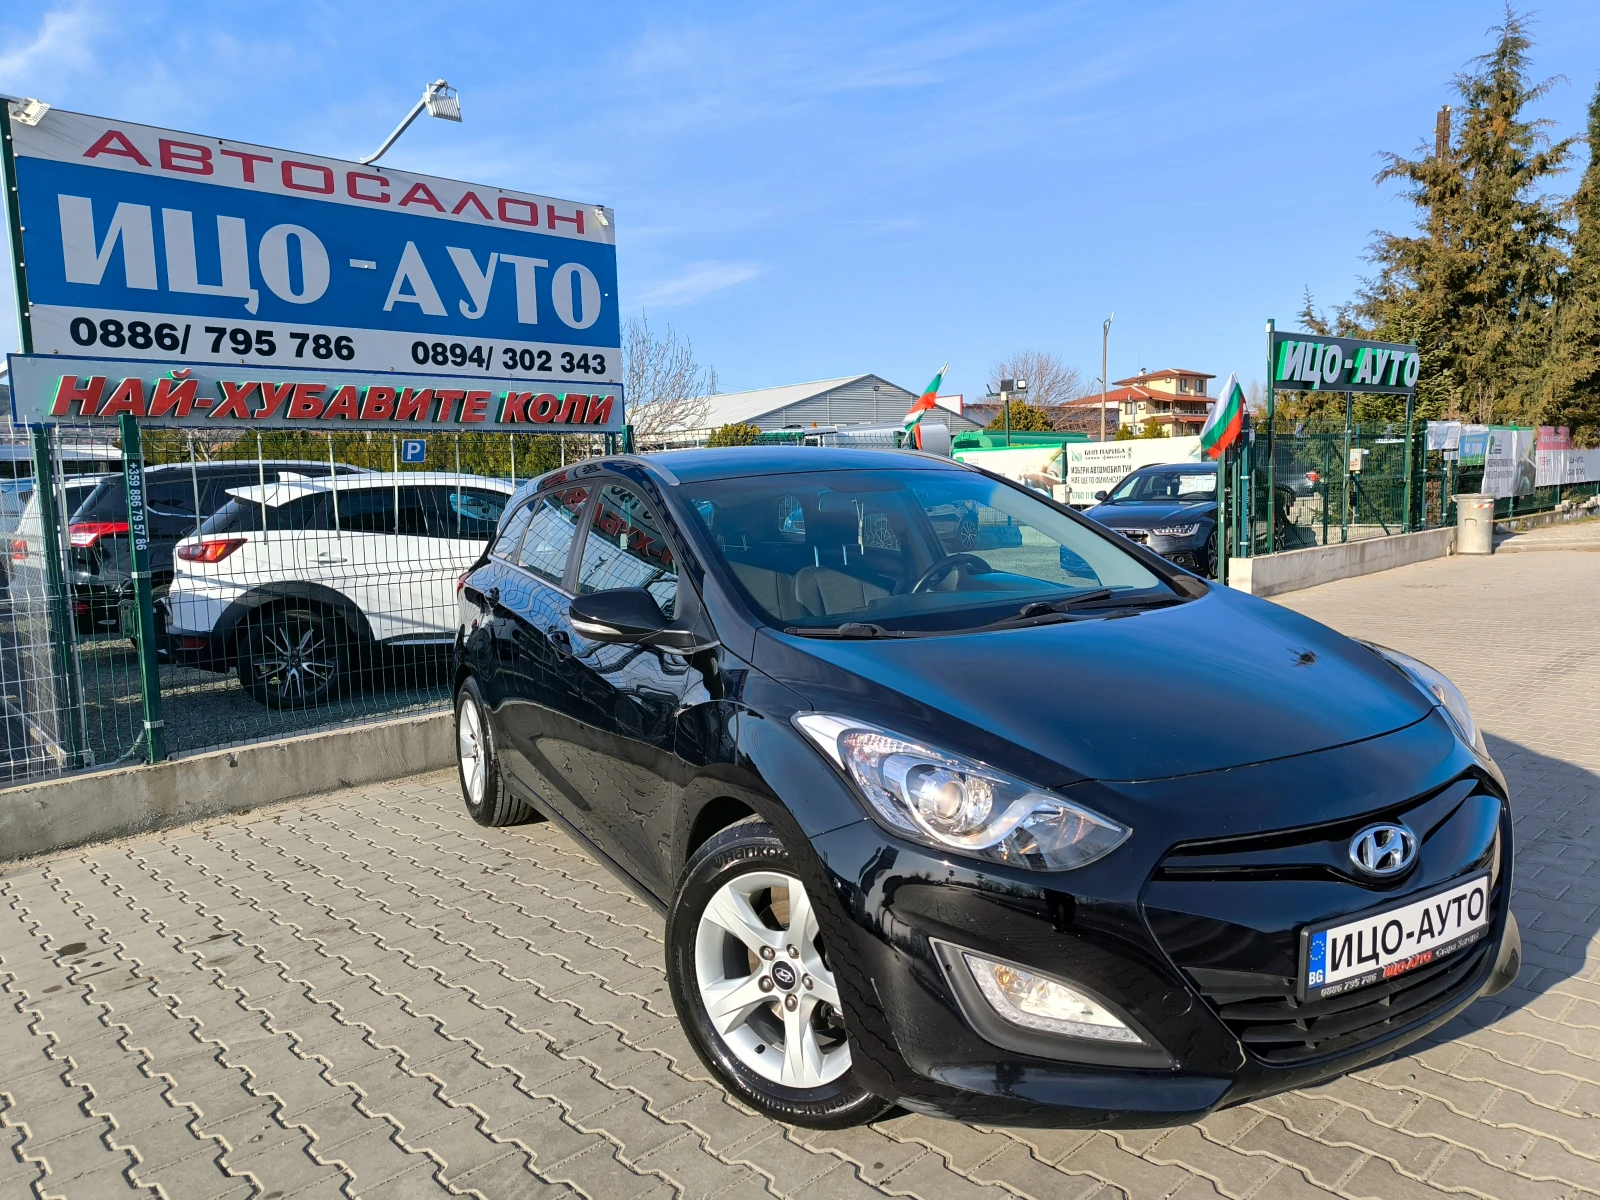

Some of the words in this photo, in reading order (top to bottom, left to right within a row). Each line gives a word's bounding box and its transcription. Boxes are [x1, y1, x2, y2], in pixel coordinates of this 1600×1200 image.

[82, 129, 584, 234] АВТОСАЛОН
[69, 316, 191, 355] 0886/
[205, 326, 276, 357] 795
[289, 332, 355, 361] 786
[411, 340, 493, 370] 0894/
[502, 348, 552, 372] 302
[560, 352, 606, 375] 343
[1279, 340, 1420, 390] ИЦО-АУТО
[50, 368, 491, 423] НАЙ-ХУБАВИТЕ
[497, 391, 615, 424] КОЛИ
[129, 462, 140, 486] +359
[130, 489, 141, 507] 886
[132, 509, 143, 522] 79
[134, 524, 145, 536] 57
[135, 538, 147, 551] 86
[1330, 887, 1485, 972] ИЦО-АУТО
[1308, 969, 1324, 986] BG
